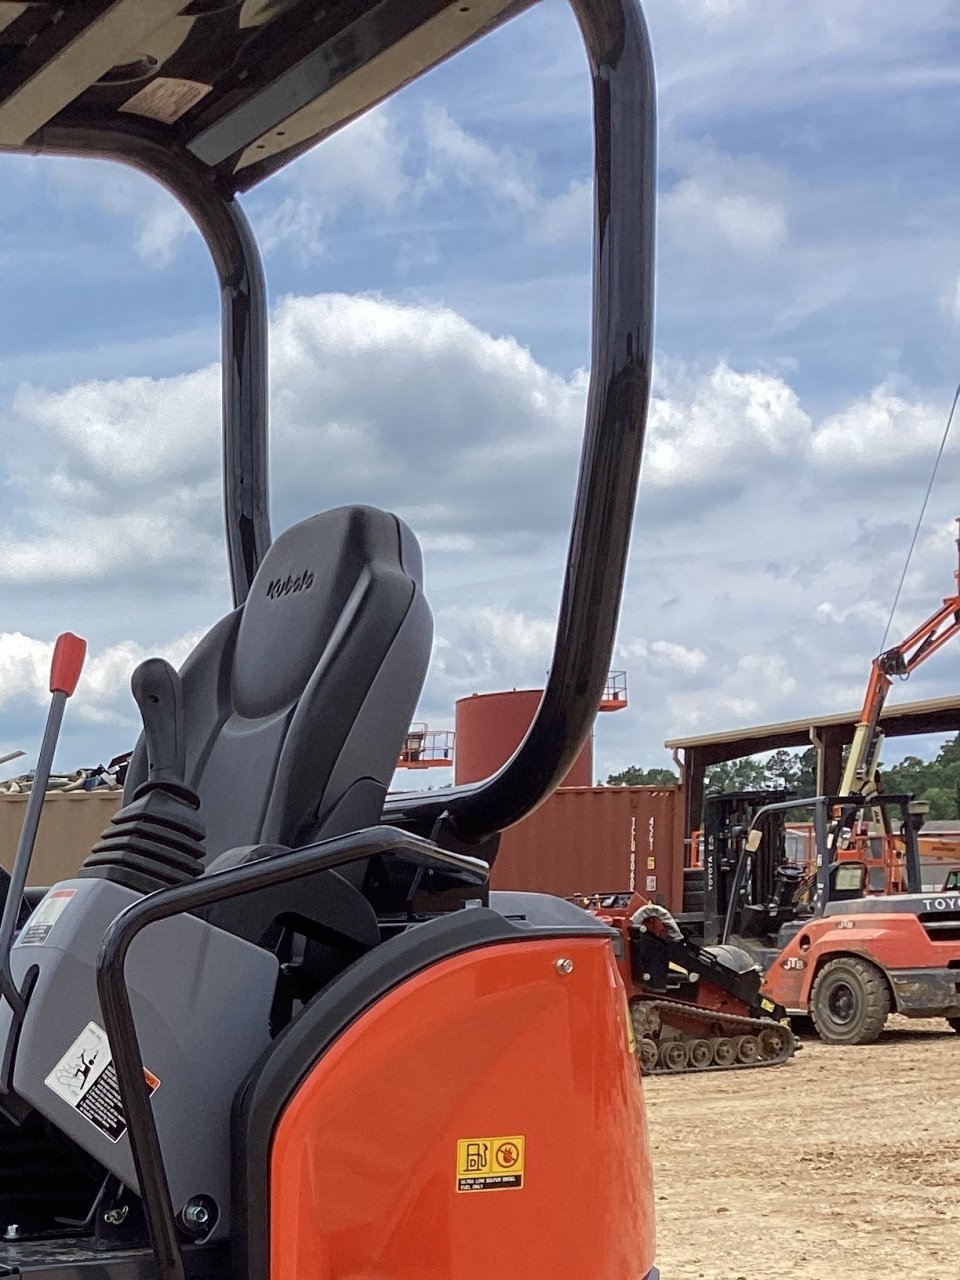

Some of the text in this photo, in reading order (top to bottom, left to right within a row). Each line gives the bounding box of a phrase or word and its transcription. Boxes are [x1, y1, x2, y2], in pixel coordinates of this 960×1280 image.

[266, 569, 315, 600] Kubota
[837, 920, 854, 929] JTB
[783, 957, 804, 970] JTB
